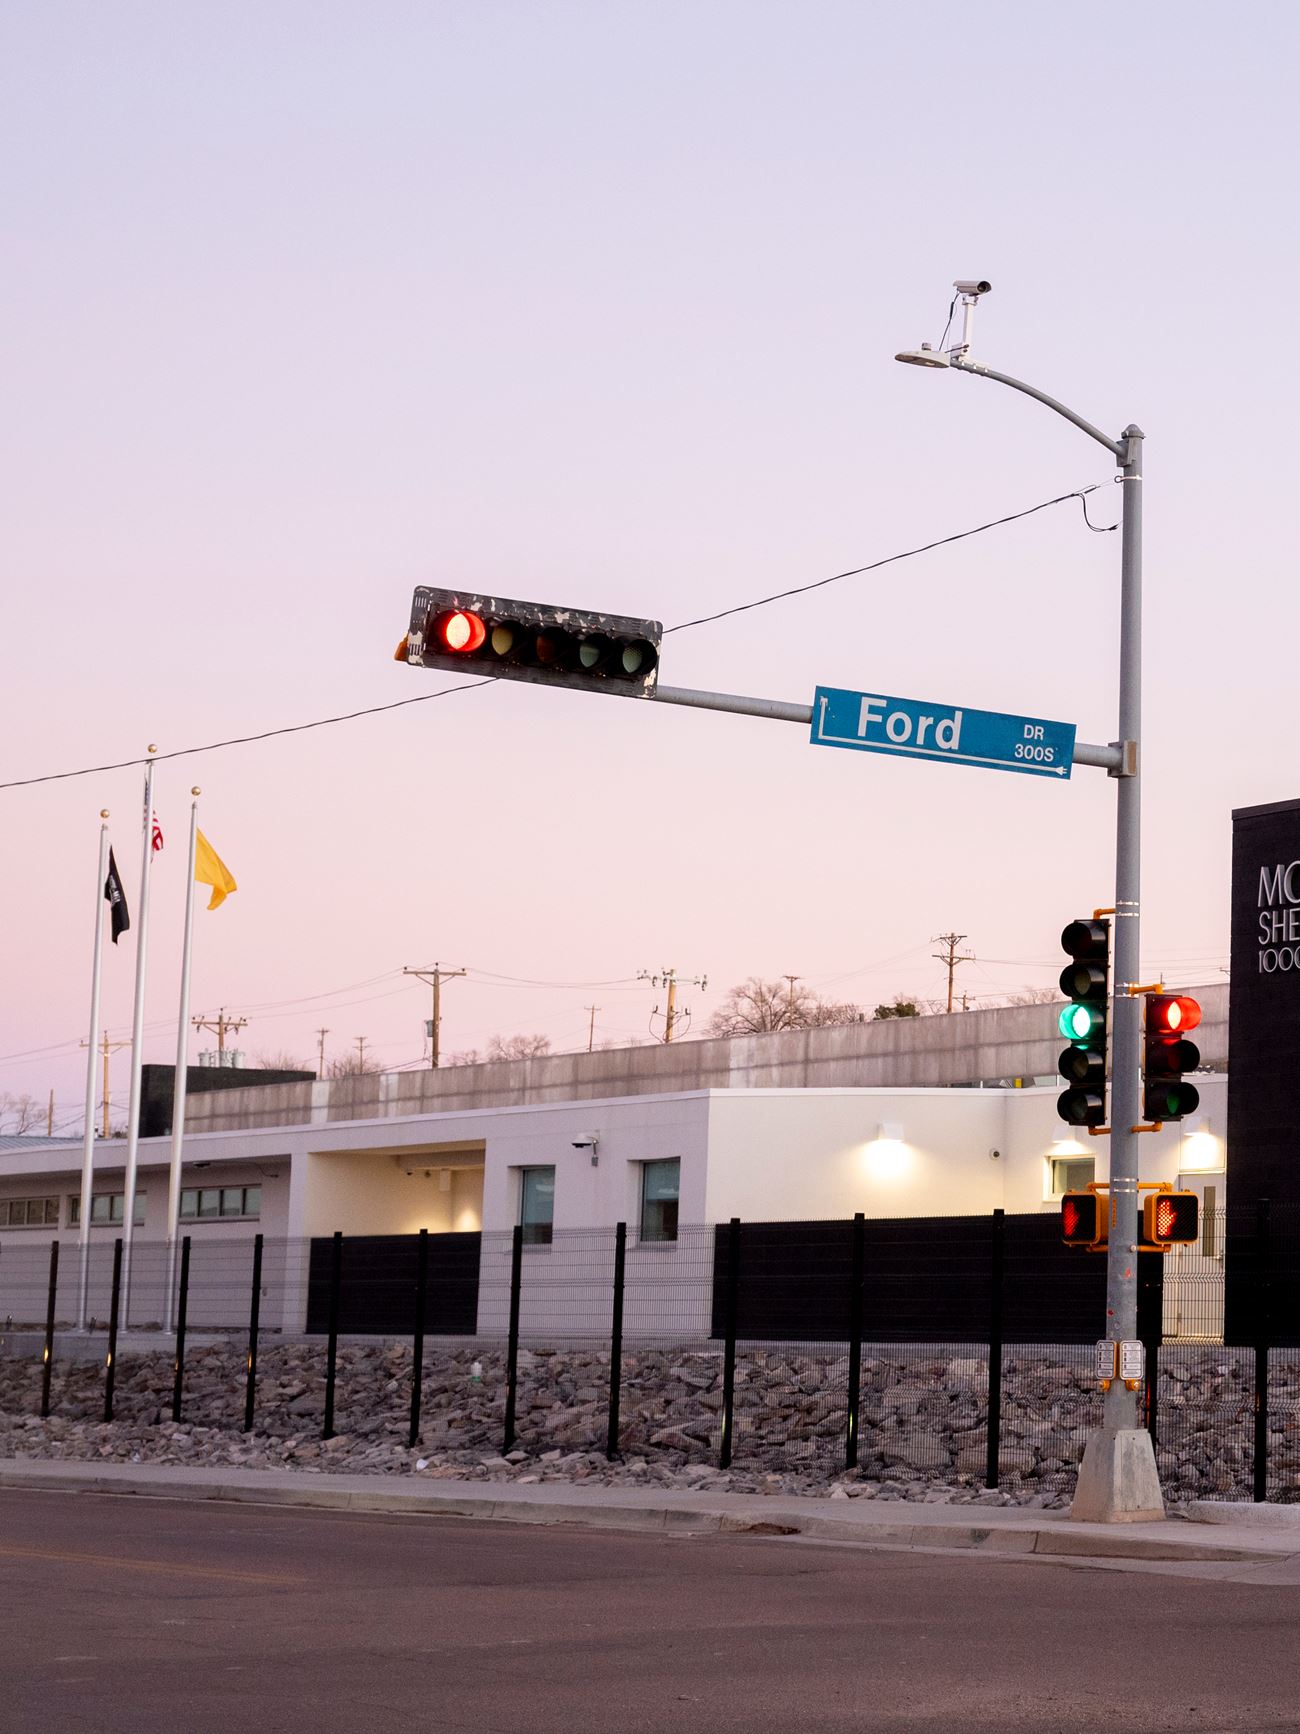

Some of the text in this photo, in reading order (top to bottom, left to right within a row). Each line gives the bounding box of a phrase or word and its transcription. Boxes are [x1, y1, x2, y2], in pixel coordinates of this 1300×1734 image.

[857, 696, 963, 750] Ford
[1023, 724, 1045, 741] DR
[1014, 743, 1054, 762] 300S
